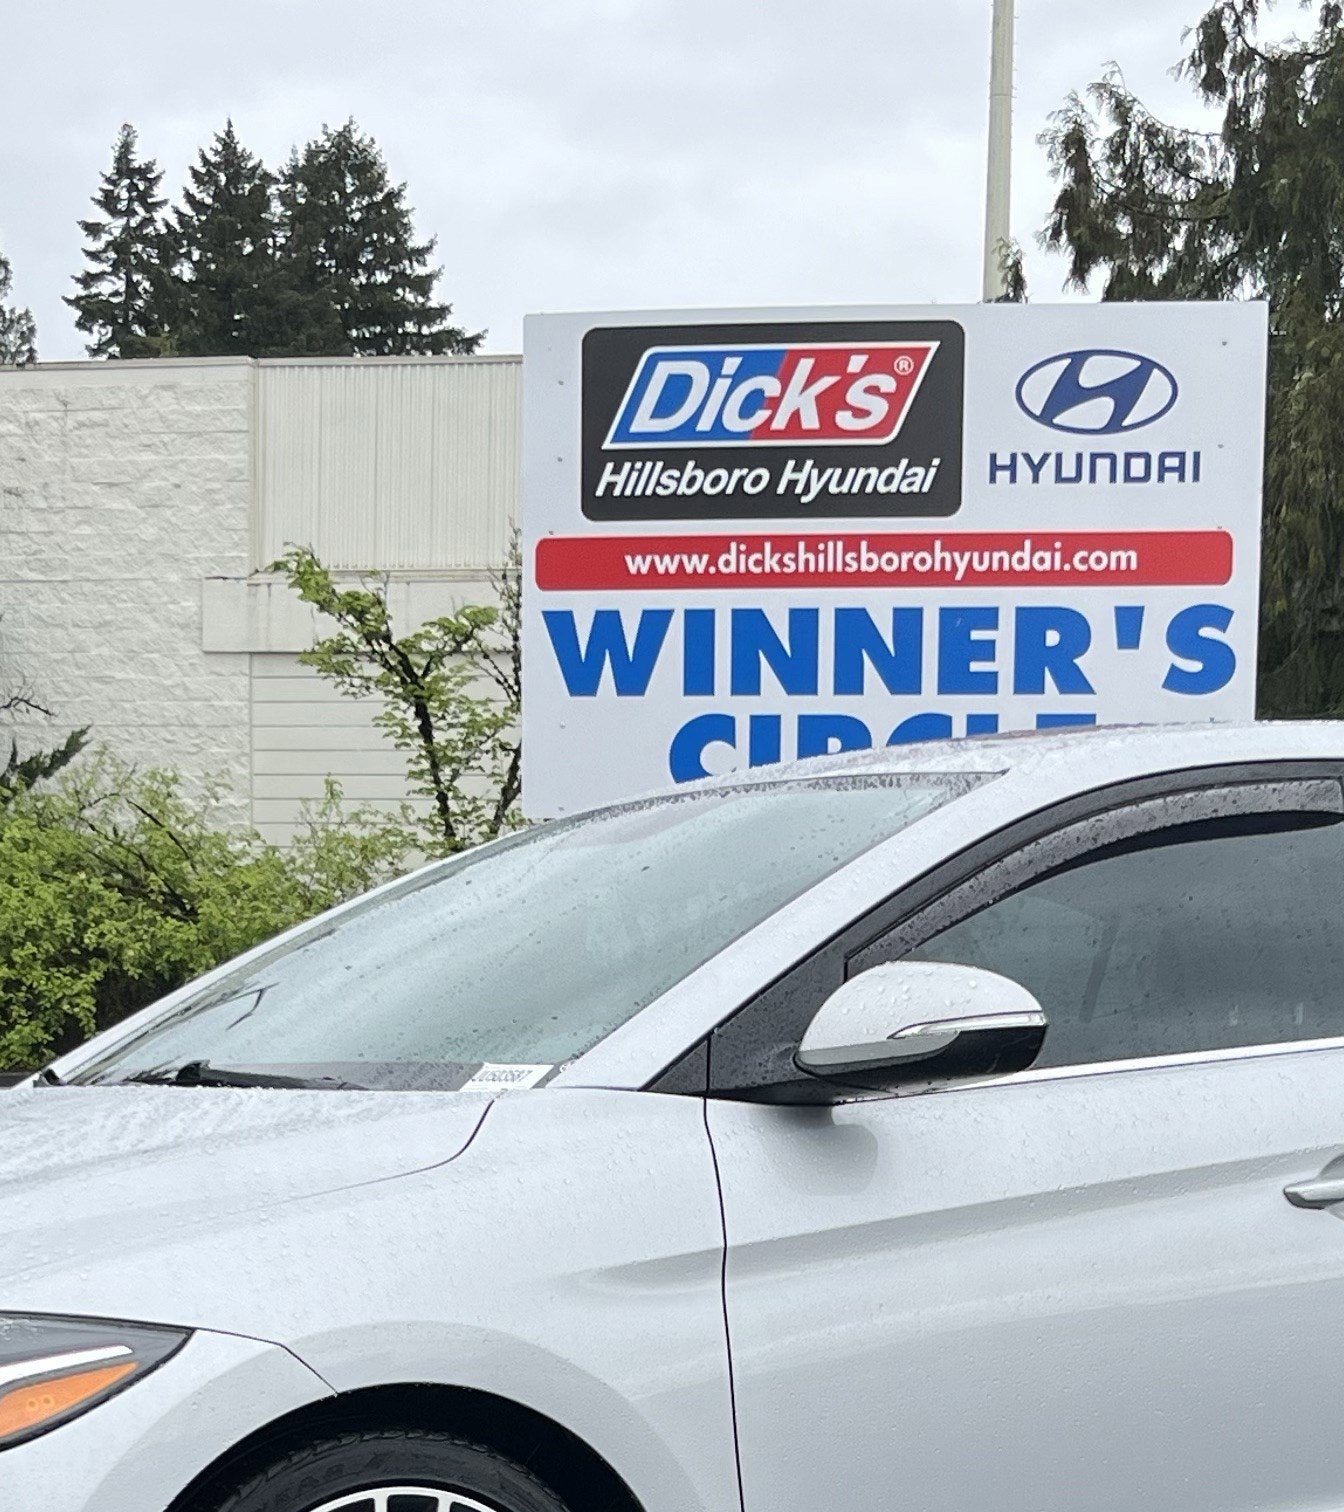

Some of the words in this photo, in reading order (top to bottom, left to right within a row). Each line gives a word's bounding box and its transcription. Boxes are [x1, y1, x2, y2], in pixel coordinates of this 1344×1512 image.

[595, 459, 769, 498] Hillsboro
[776, 457, 940, 503] Hyundai
[989, 450, 1202, 485] HYUNDAI
[624, 539, 1138, 580] www.dickshillsborohyundai.com
[542, 604, 1237, 697] WINNER'S
